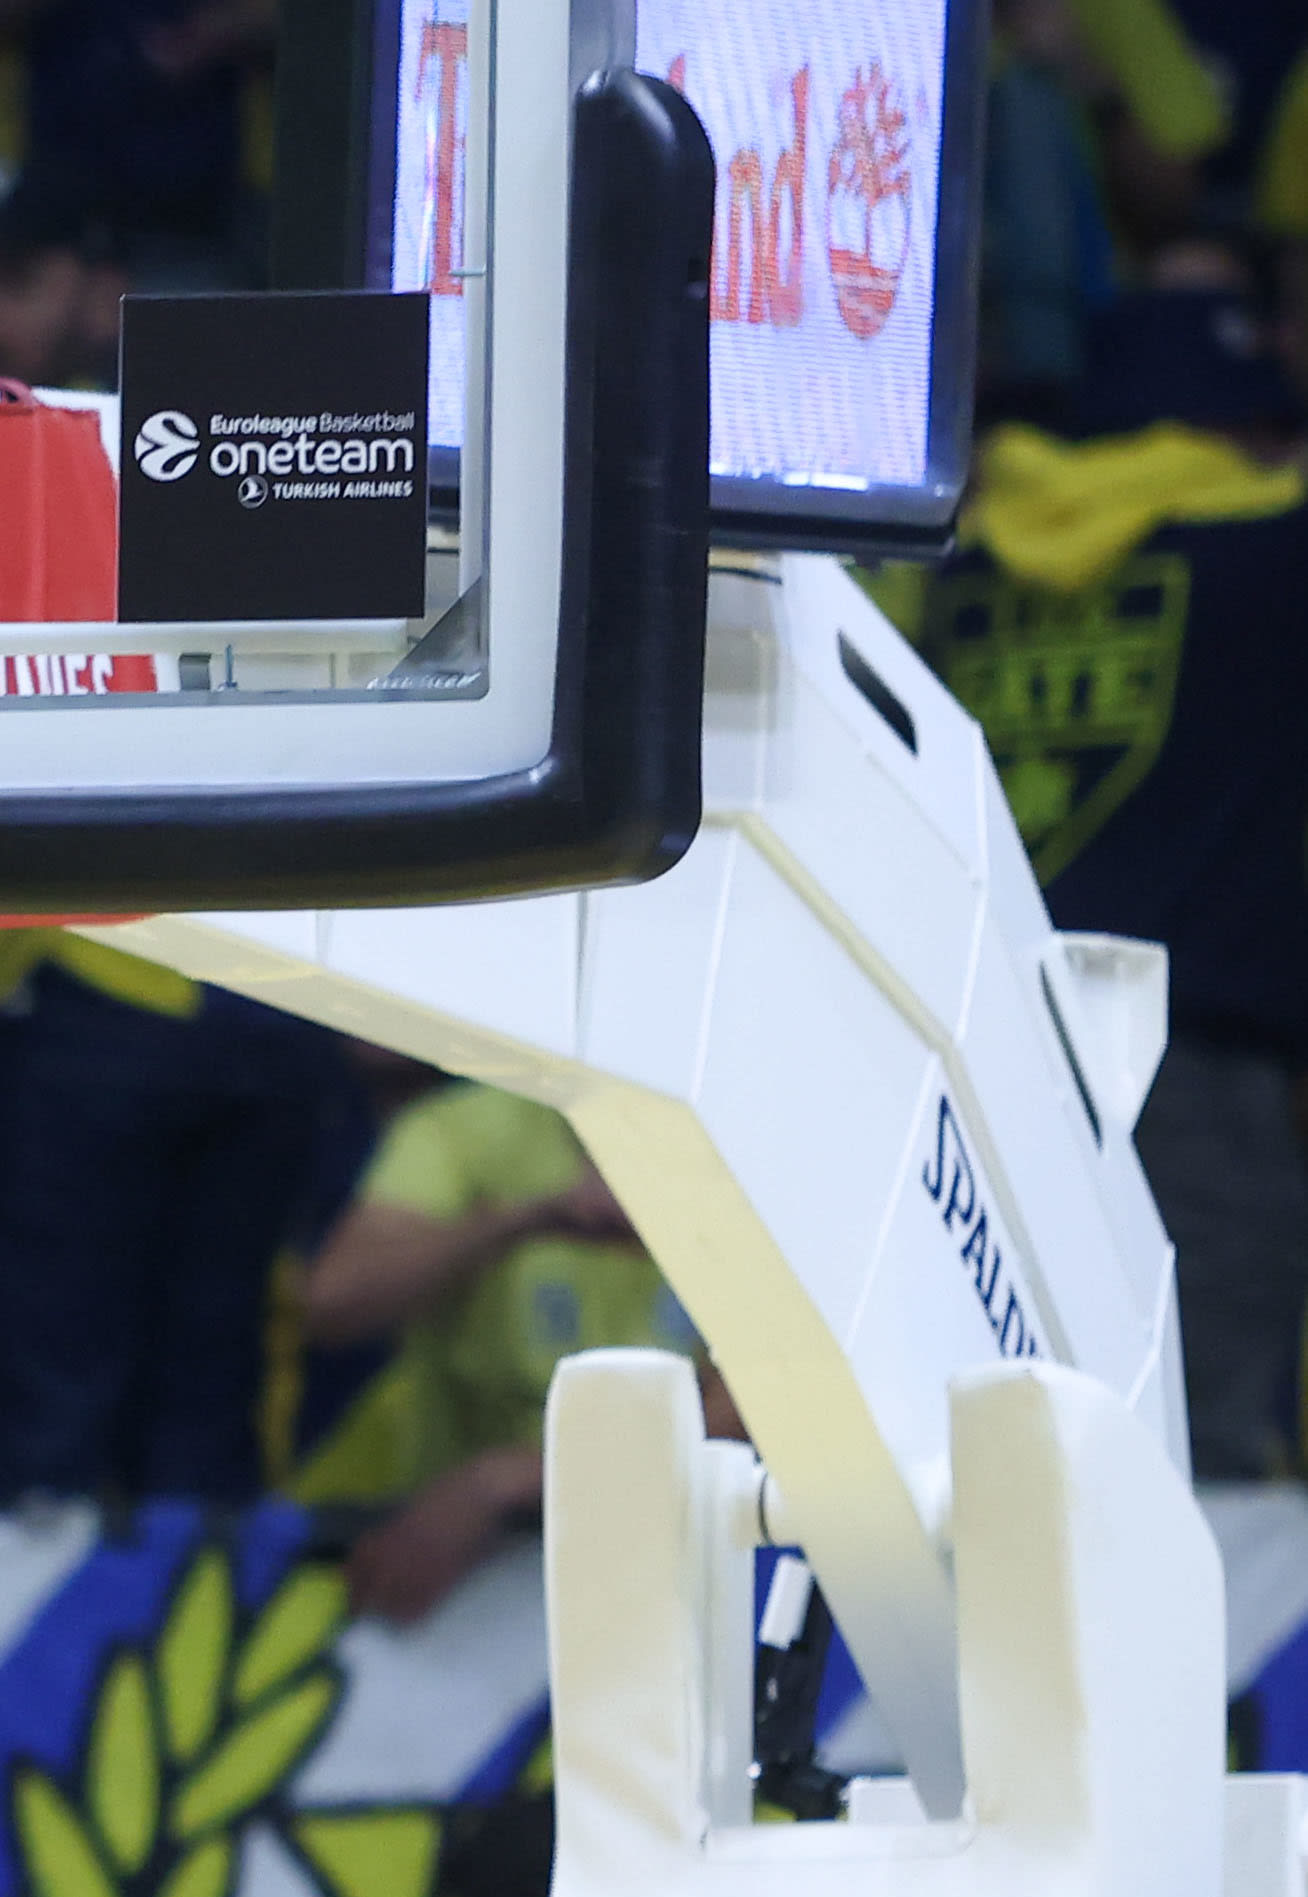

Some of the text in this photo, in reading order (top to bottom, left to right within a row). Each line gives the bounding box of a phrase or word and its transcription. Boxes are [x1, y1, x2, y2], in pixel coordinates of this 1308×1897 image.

[210, 410, 415, 438] Euroleague Basketball
[210, 433, 415, 477] oneteam
[273, 480, 414, 499] TURKISH AIRLINES
[922, 1095, 1040, 1357] SPALD
